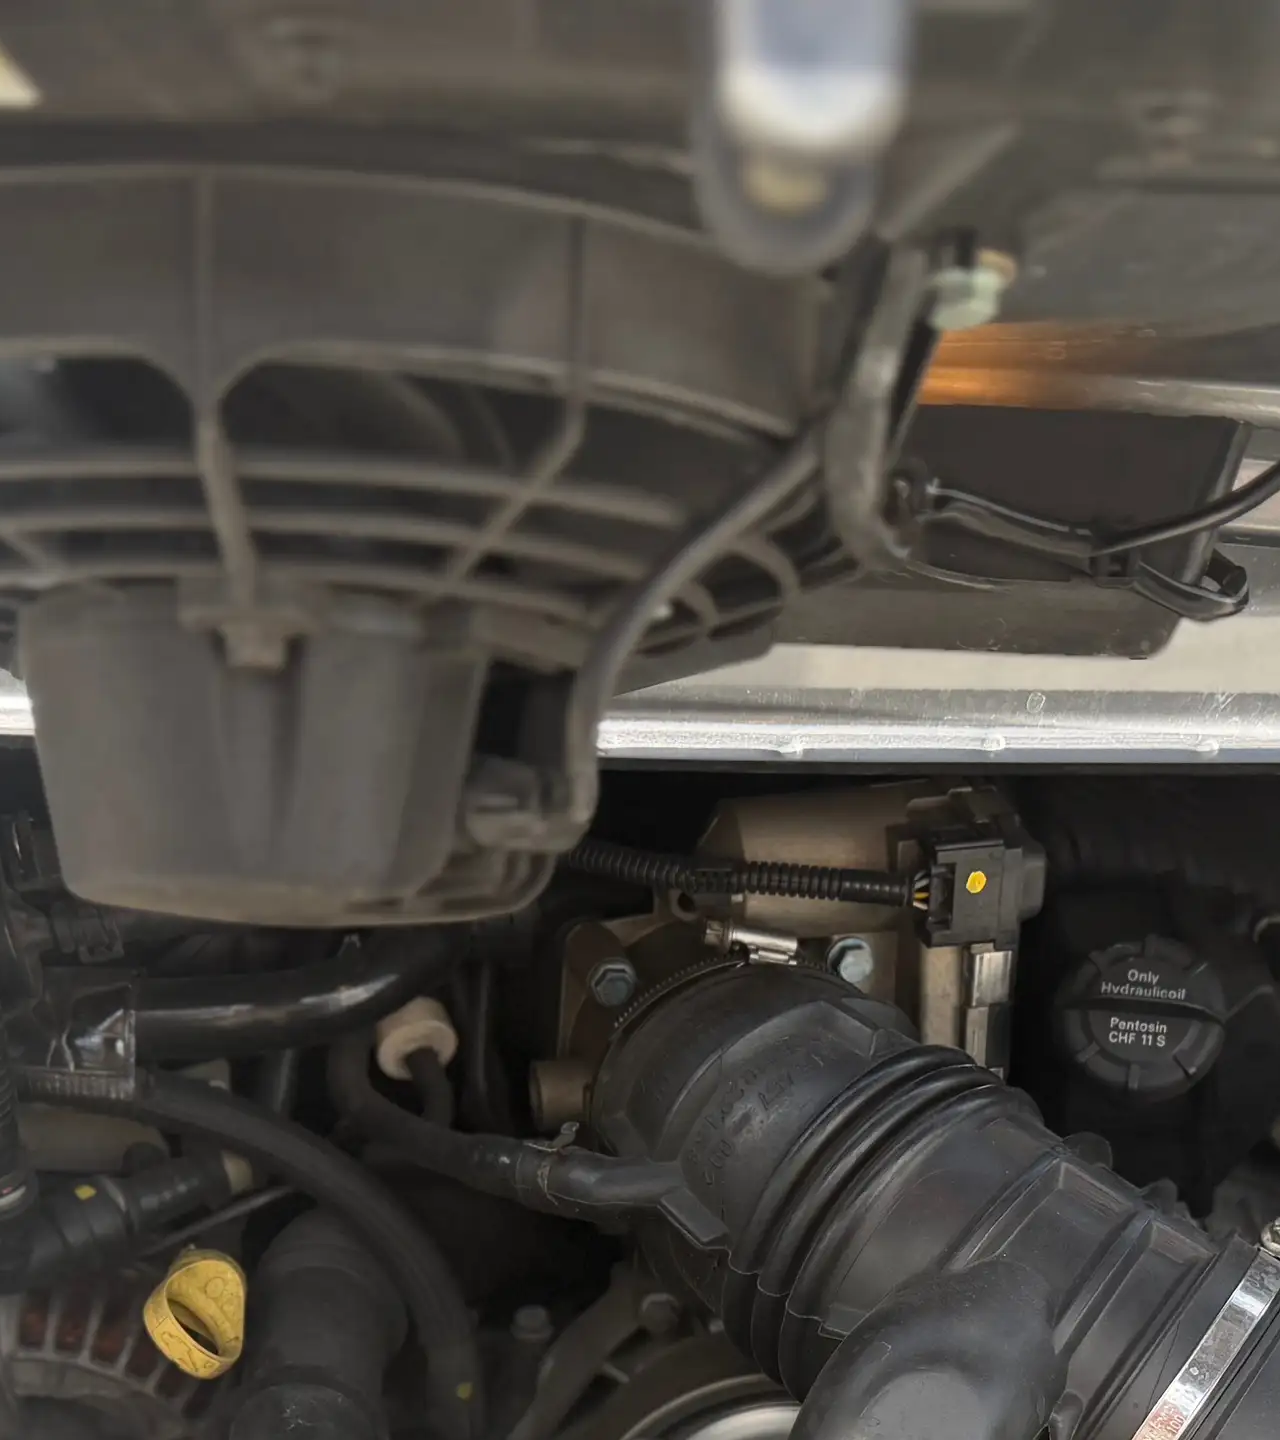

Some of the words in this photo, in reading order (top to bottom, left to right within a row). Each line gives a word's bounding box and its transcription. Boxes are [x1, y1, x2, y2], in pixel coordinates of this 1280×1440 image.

[1127, 968, 1160, 985] Only
[1101, 981, 1187, 1000] Hydraulicoil
[1109, 1016, 1167, 1034] Pentosin
[1108, 1030, 1137, 1044] CHF
[1141, 1033, 1153, 1046] 11
[1156, 1034, 1166, 1048] S
